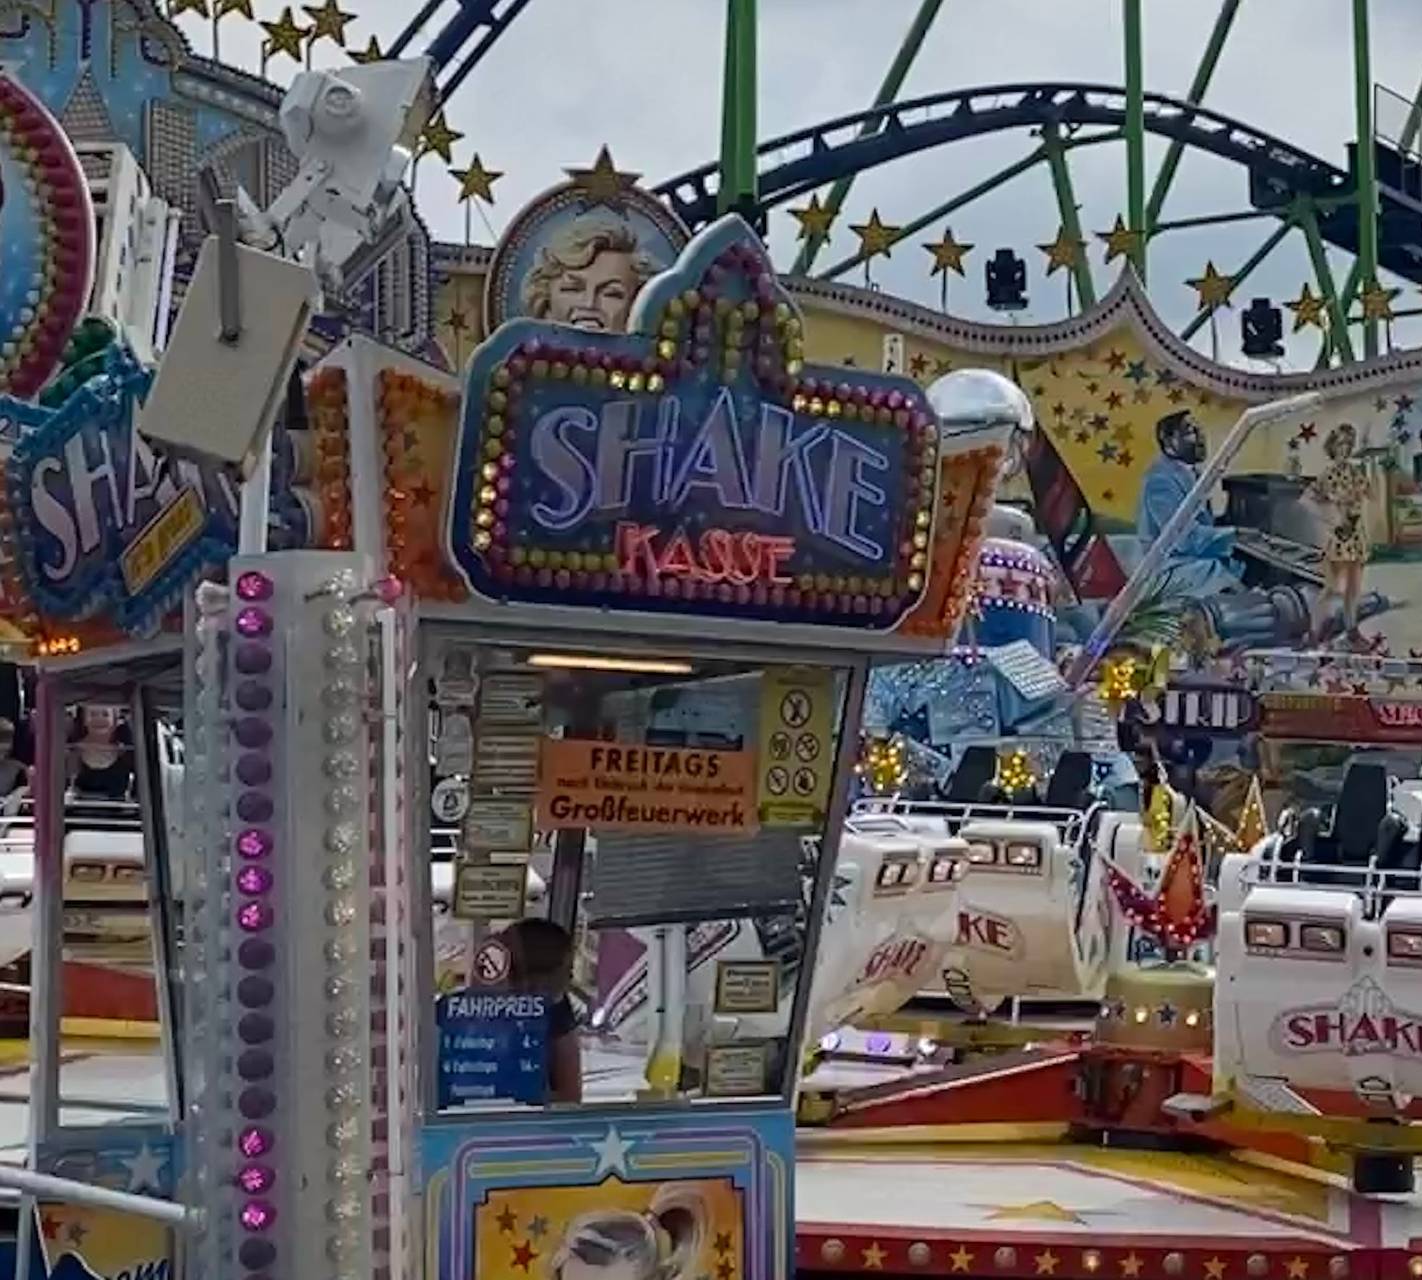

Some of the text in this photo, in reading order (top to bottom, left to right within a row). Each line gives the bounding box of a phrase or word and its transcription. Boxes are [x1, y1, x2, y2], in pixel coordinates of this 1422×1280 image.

[530, 386, 889, 561] SHAKE
[613, 518, 796, 586] KASSE
[590, 747, 719, 778] FREITAGS
[550, 795, 744, 826] Großfeuerwerk
[446, 996, 545, 1018] FAHRPREIS
